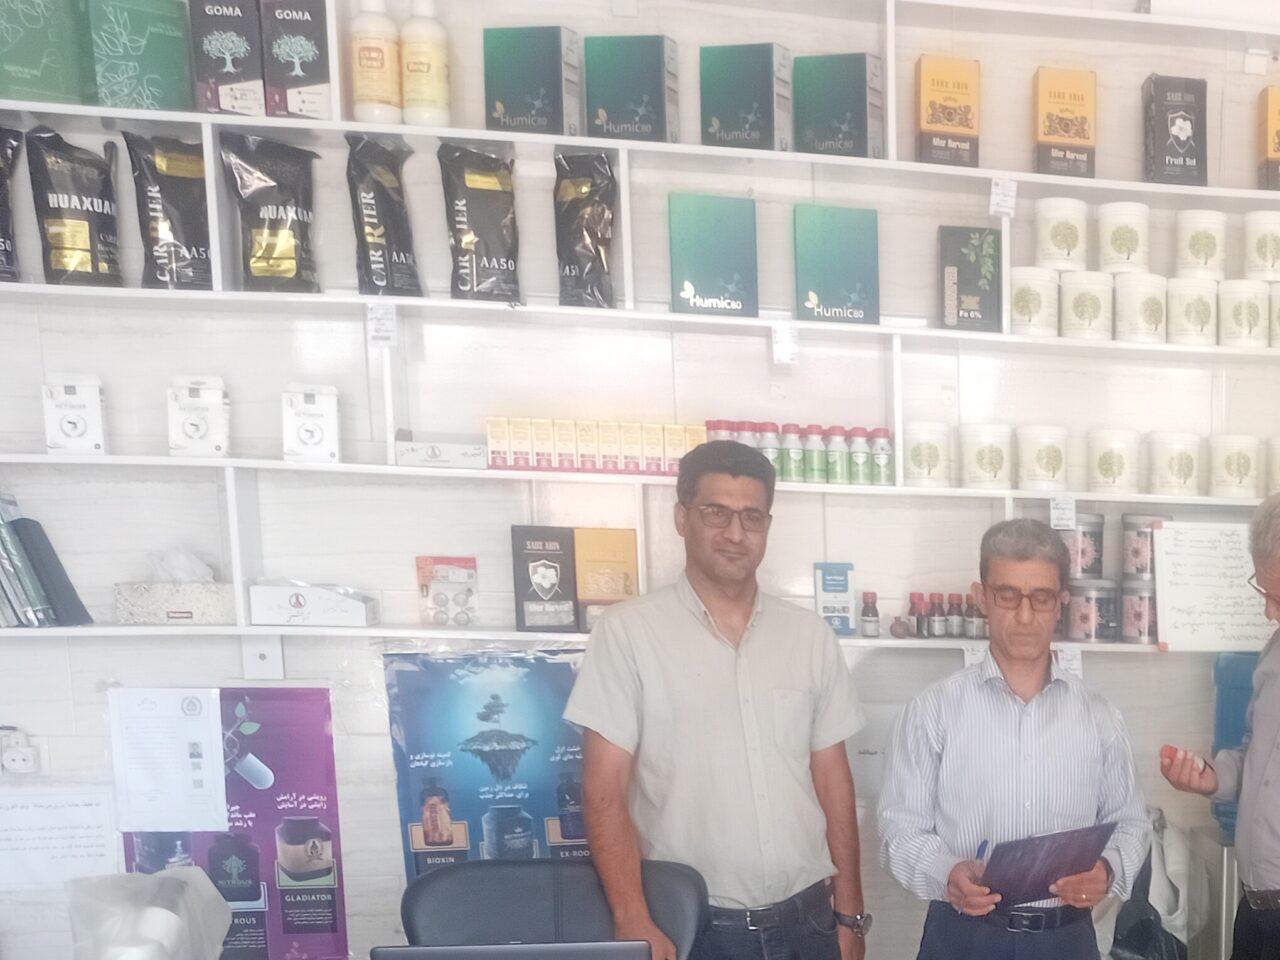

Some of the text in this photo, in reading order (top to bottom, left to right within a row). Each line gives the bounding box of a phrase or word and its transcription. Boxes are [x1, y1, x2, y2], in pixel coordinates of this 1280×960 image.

[204, 4, 243, 17] GOMA
[274, 9, 311, 21] GOMA
[285, 894, 332, 902] GLADIATOR
